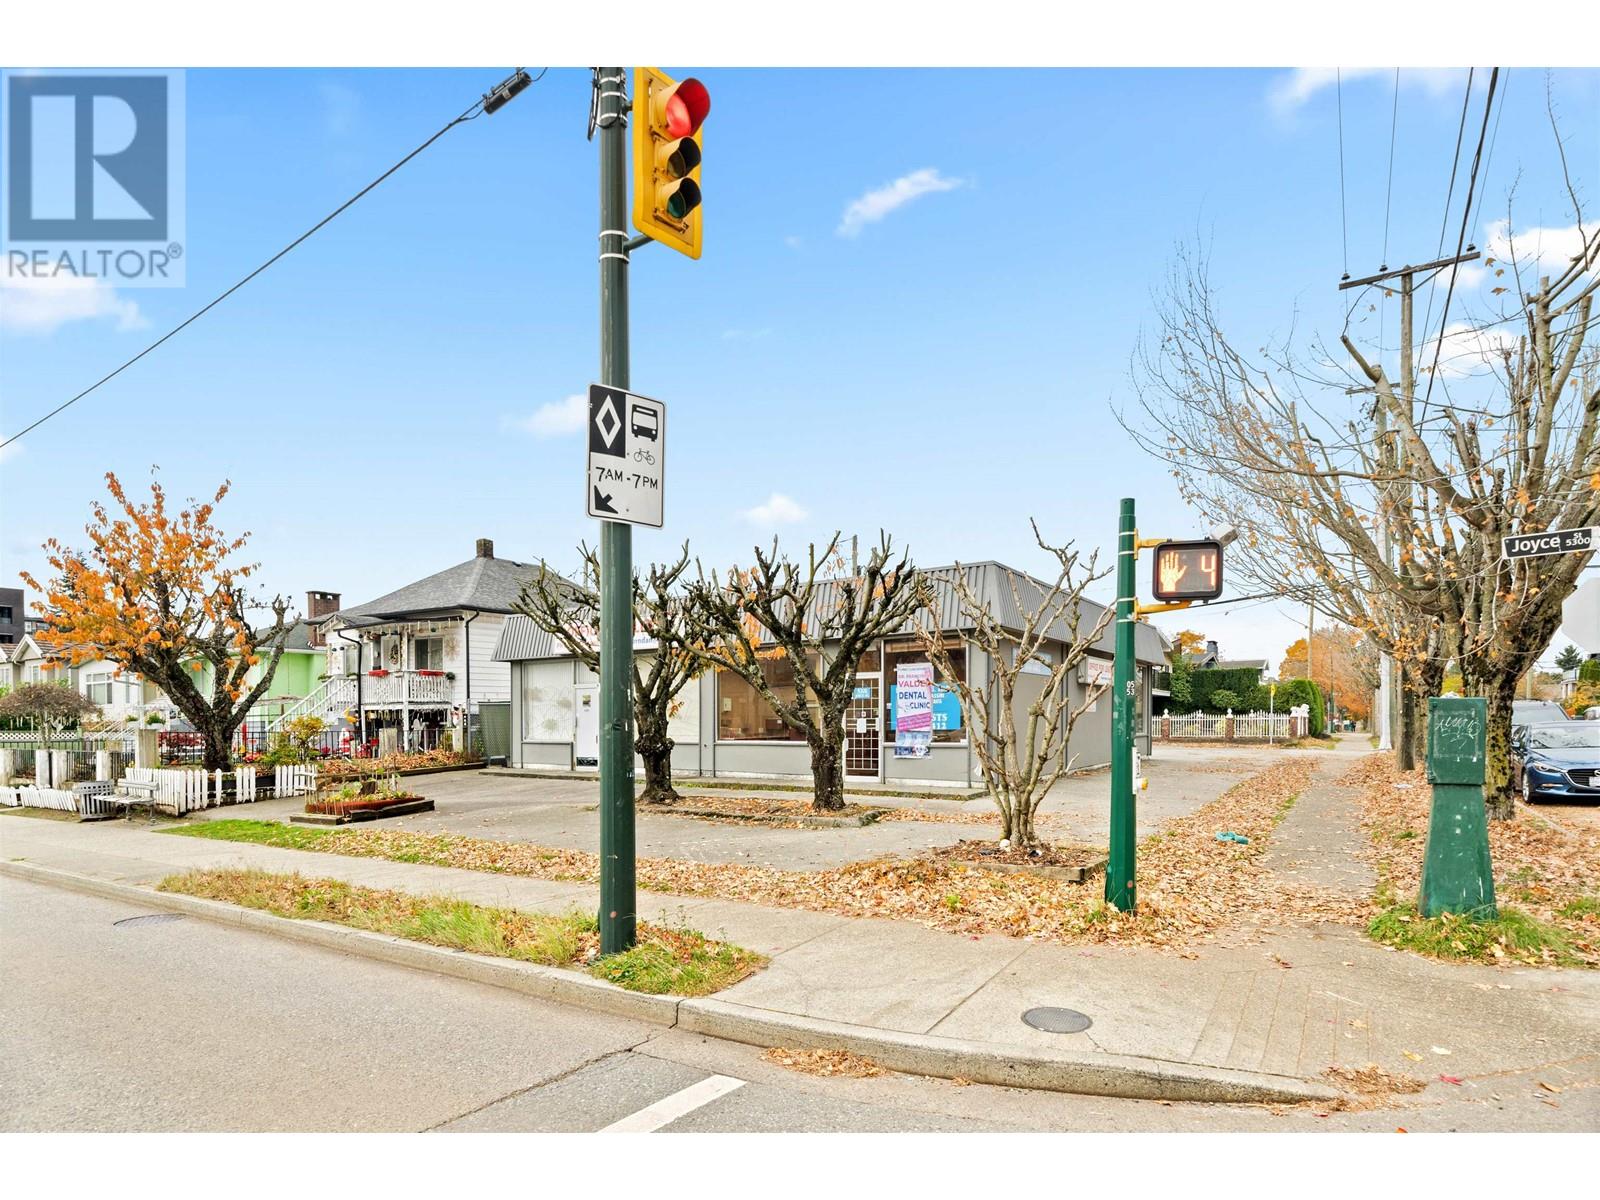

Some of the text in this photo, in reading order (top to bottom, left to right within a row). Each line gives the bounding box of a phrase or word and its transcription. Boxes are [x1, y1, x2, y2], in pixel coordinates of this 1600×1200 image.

[1573, 532, 1583, 540] St
[1511, 536, 1561, 554] Joyce
[1565, 537, 1591, 548] 5300
[1200, 554, 1216, 587] 4
[898, 691, 927, 700] DENTAL
[1126, 688, 1135, 696] 53
[909, 701, 931, 710] CLINIC
